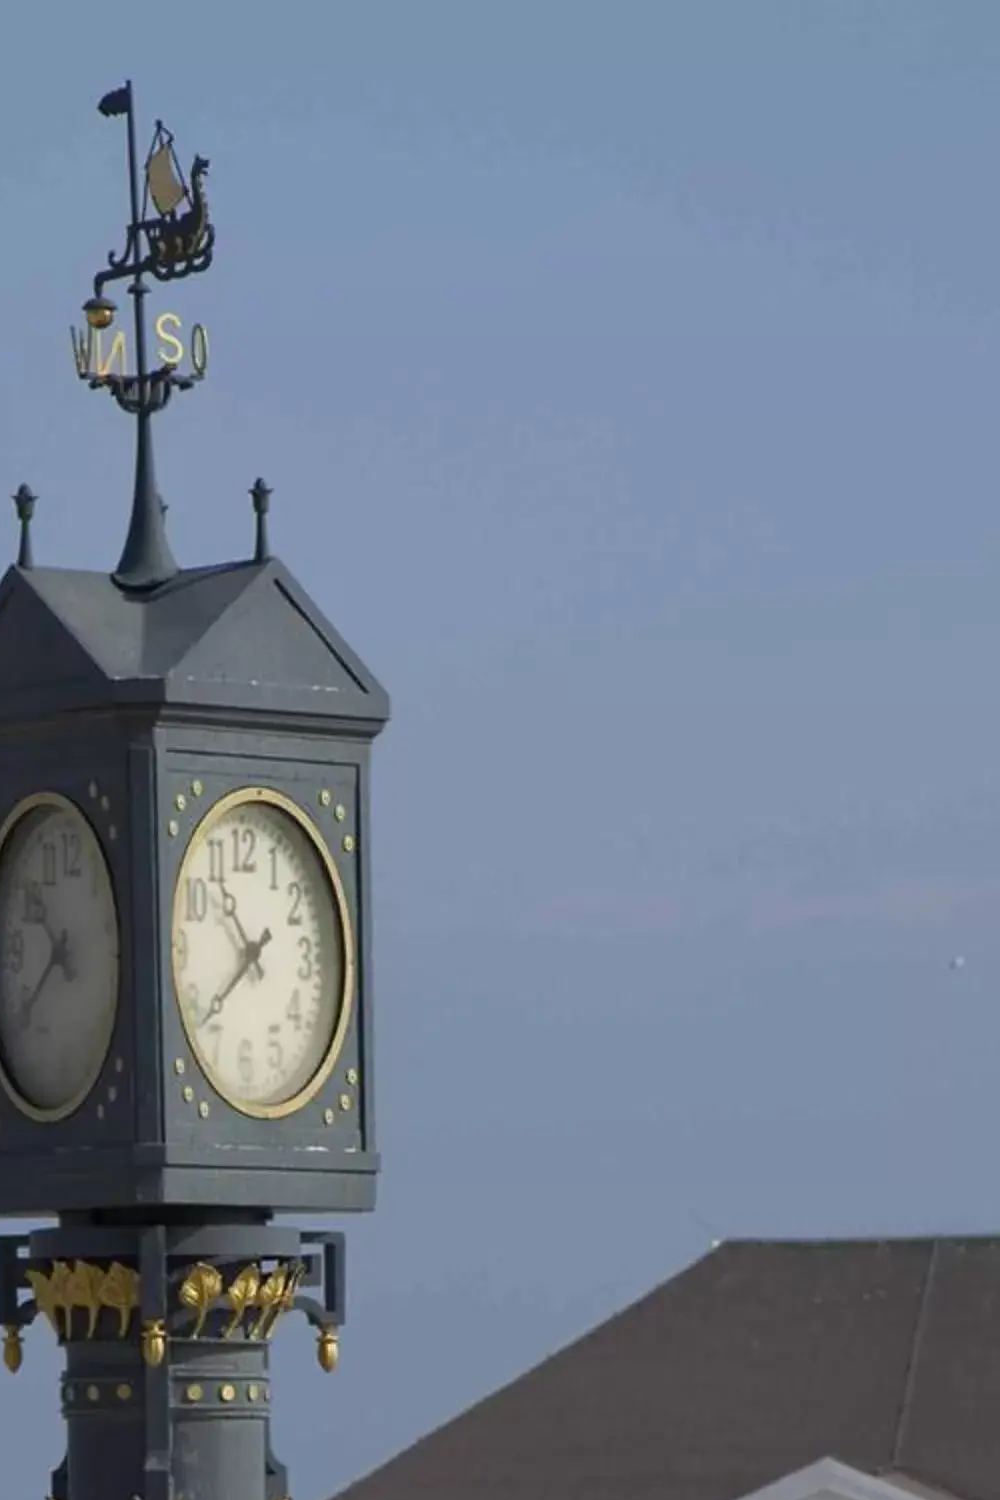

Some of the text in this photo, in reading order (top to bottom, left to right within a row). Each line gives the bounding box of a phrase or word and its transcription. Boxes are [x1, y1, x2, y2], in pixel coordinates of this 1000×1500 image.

[156, 312, 183, 364] S
[61, 832, 82, 878] 12
[207, 839, 226, 883] 11
[232, 828, 256, 873] 12
[268, 847, 280, 891] 1
[185, 877, 207, 922] 10
[287, 881, 301, 926] 2
[298, 936, 312, 981] 3
[286, 987, 302, 1032] 4
[237, 1038, 253, 1083] 6
[268, 1024, 283, 1069] 5
